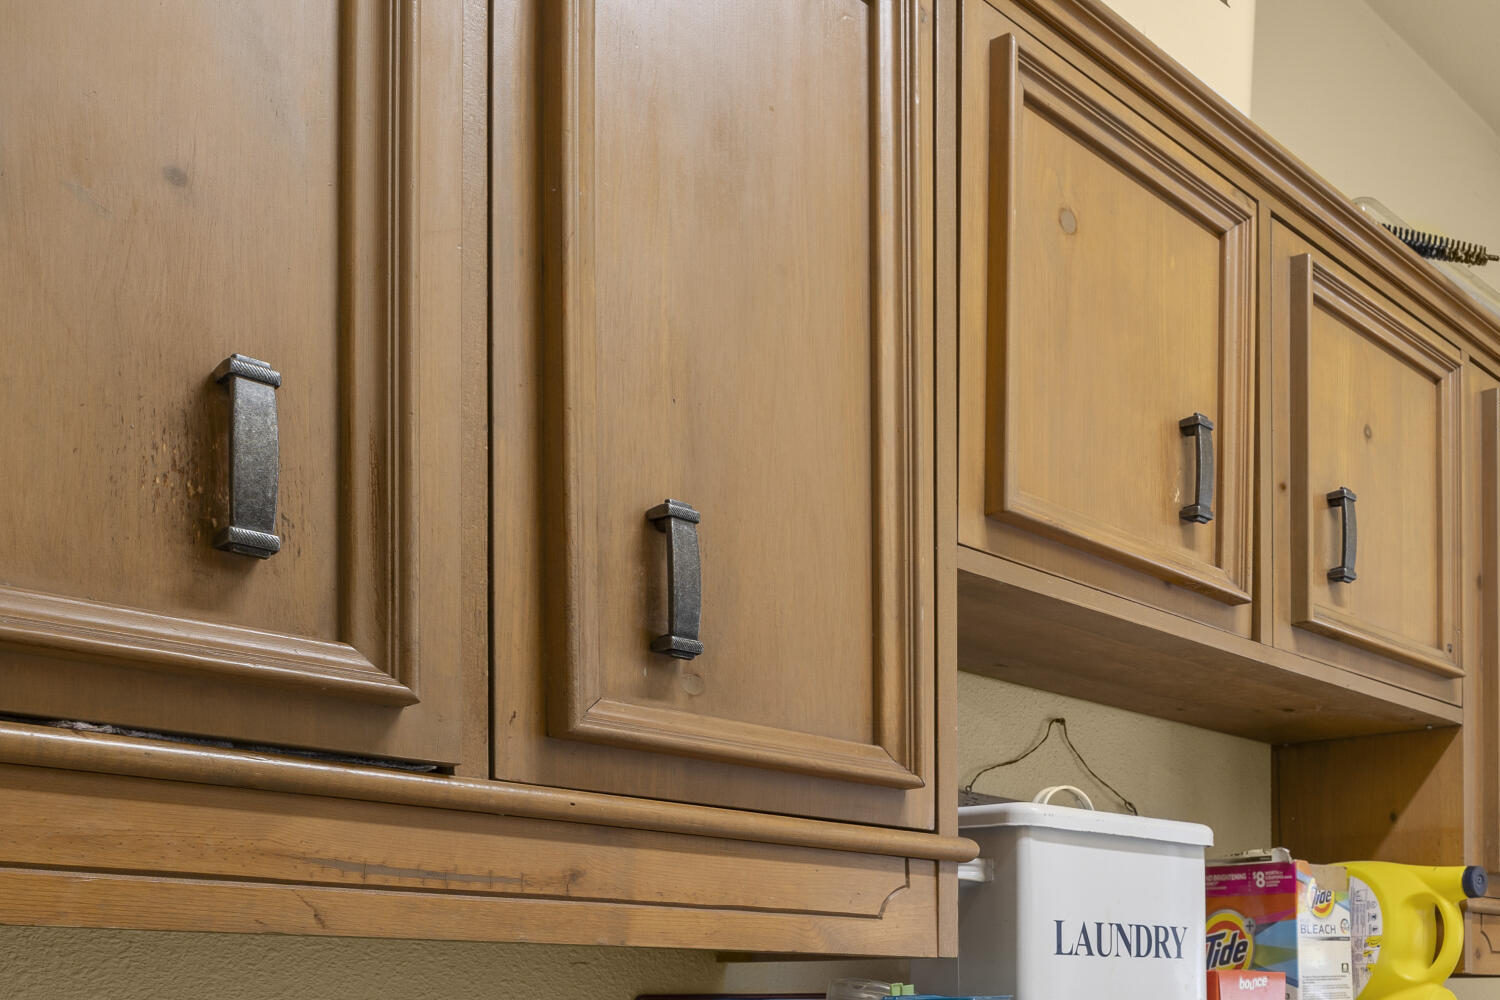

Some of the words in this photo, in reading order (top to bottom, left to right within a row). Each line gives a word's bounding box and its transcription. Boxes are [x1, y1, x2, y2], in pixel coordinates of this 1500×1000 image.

[1312, 888, 1332, 909] Tide
[1053, 919, 1189, 959] LAUNDRY
[1300, 924, 1337, 935] BLEACH
[1206, 930, 1249, 970] Tide
[1239, 975, 1269, 990] bounce
